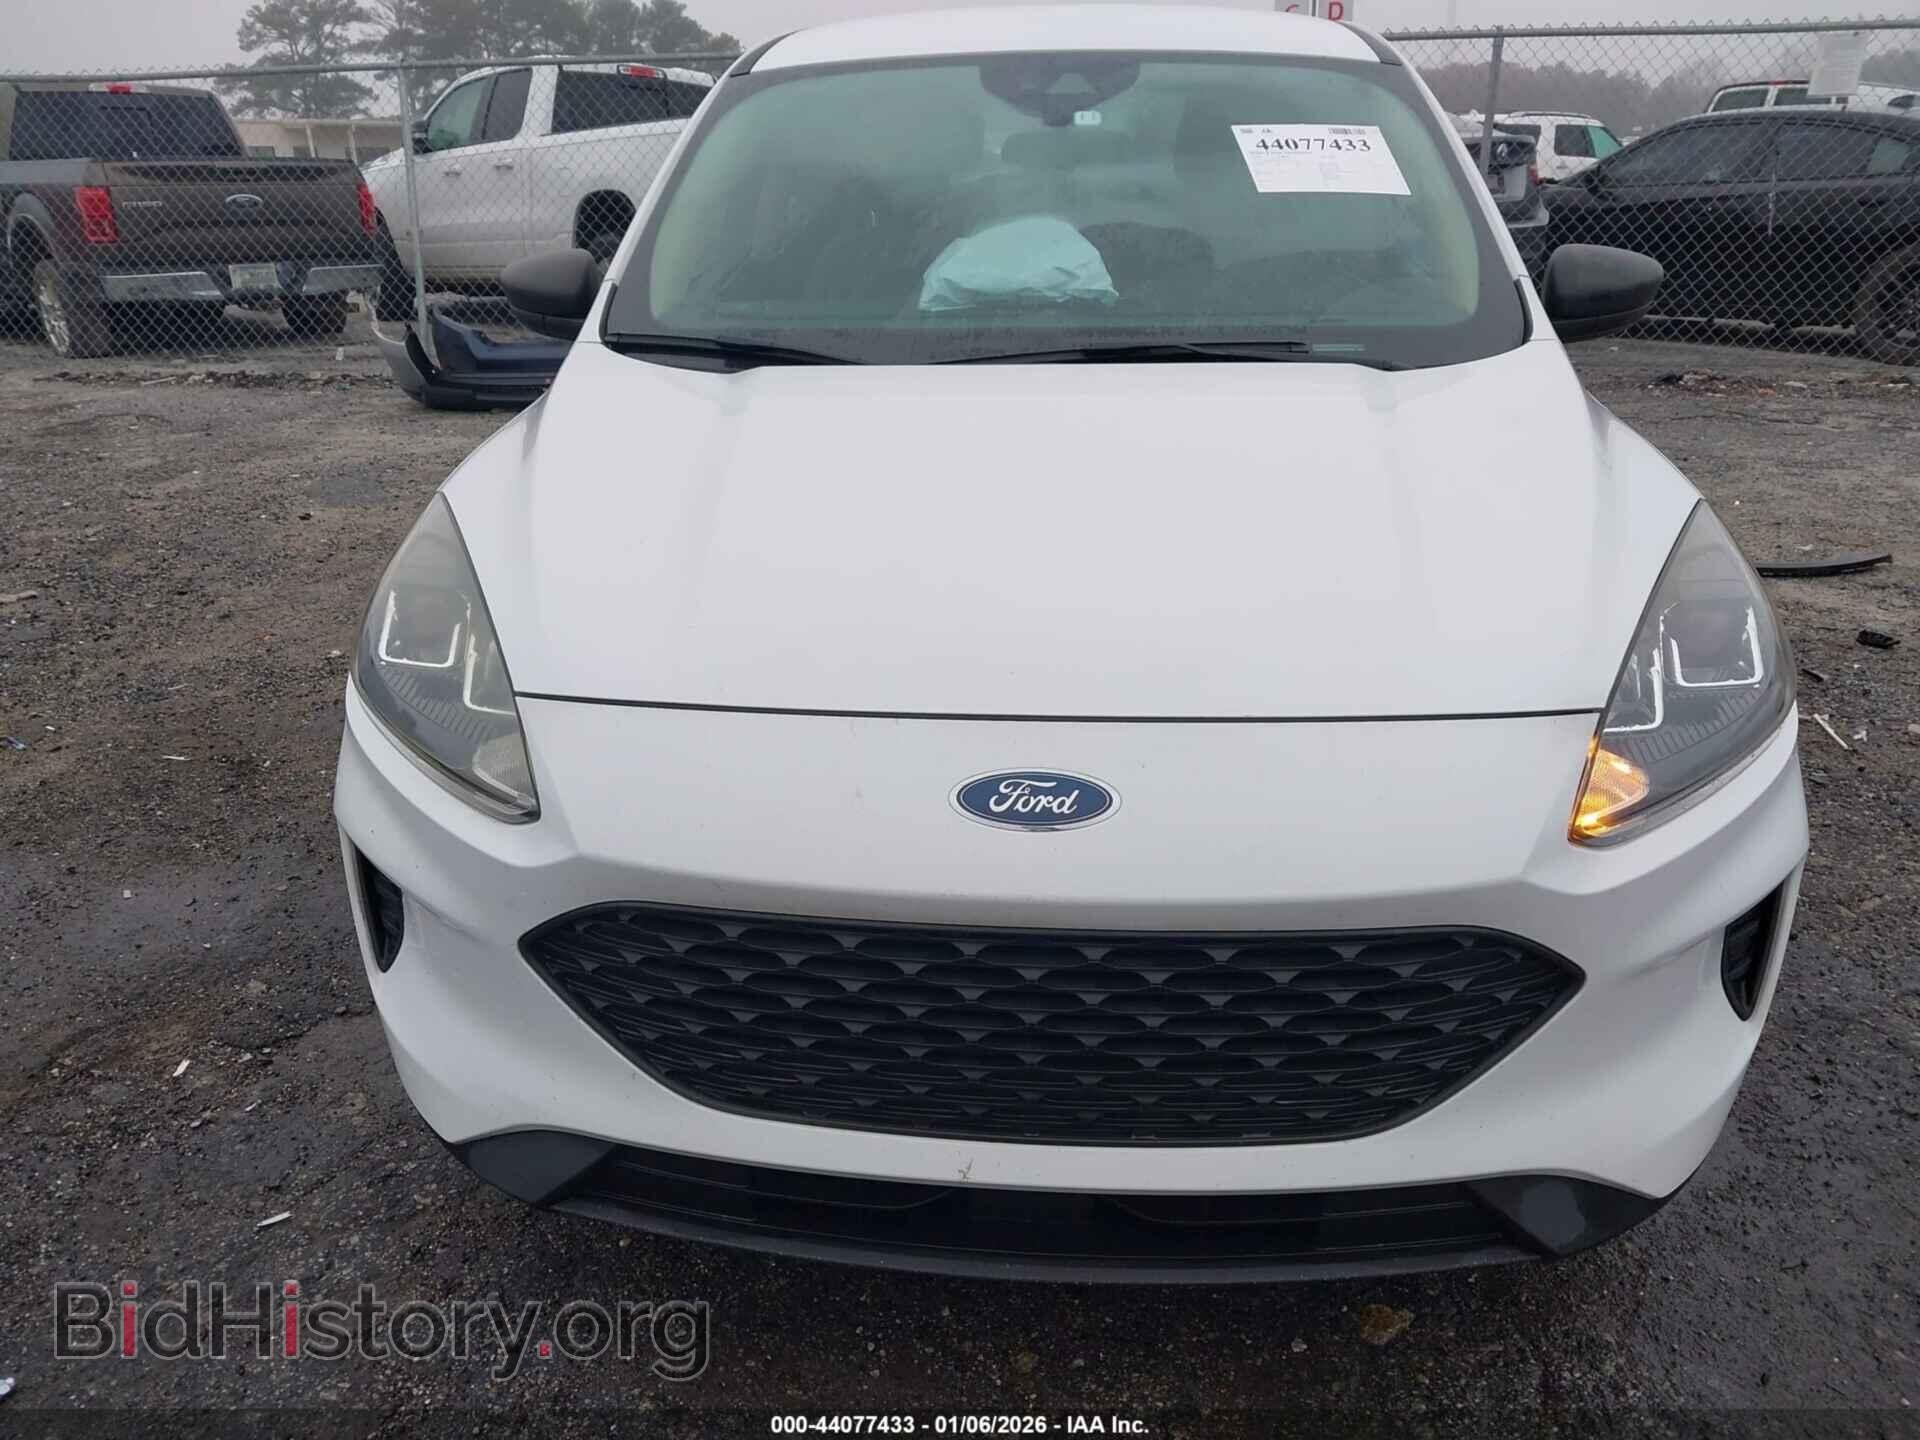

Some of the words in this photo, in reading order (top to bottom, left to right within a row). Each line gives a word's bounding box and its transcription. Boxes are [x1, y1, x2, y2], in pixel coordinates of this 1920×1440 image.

[1328, 1, 1344, 21] D
[1255, 138, 1371, 152] 44077433
[988, 778, 1081, 815] Ford
